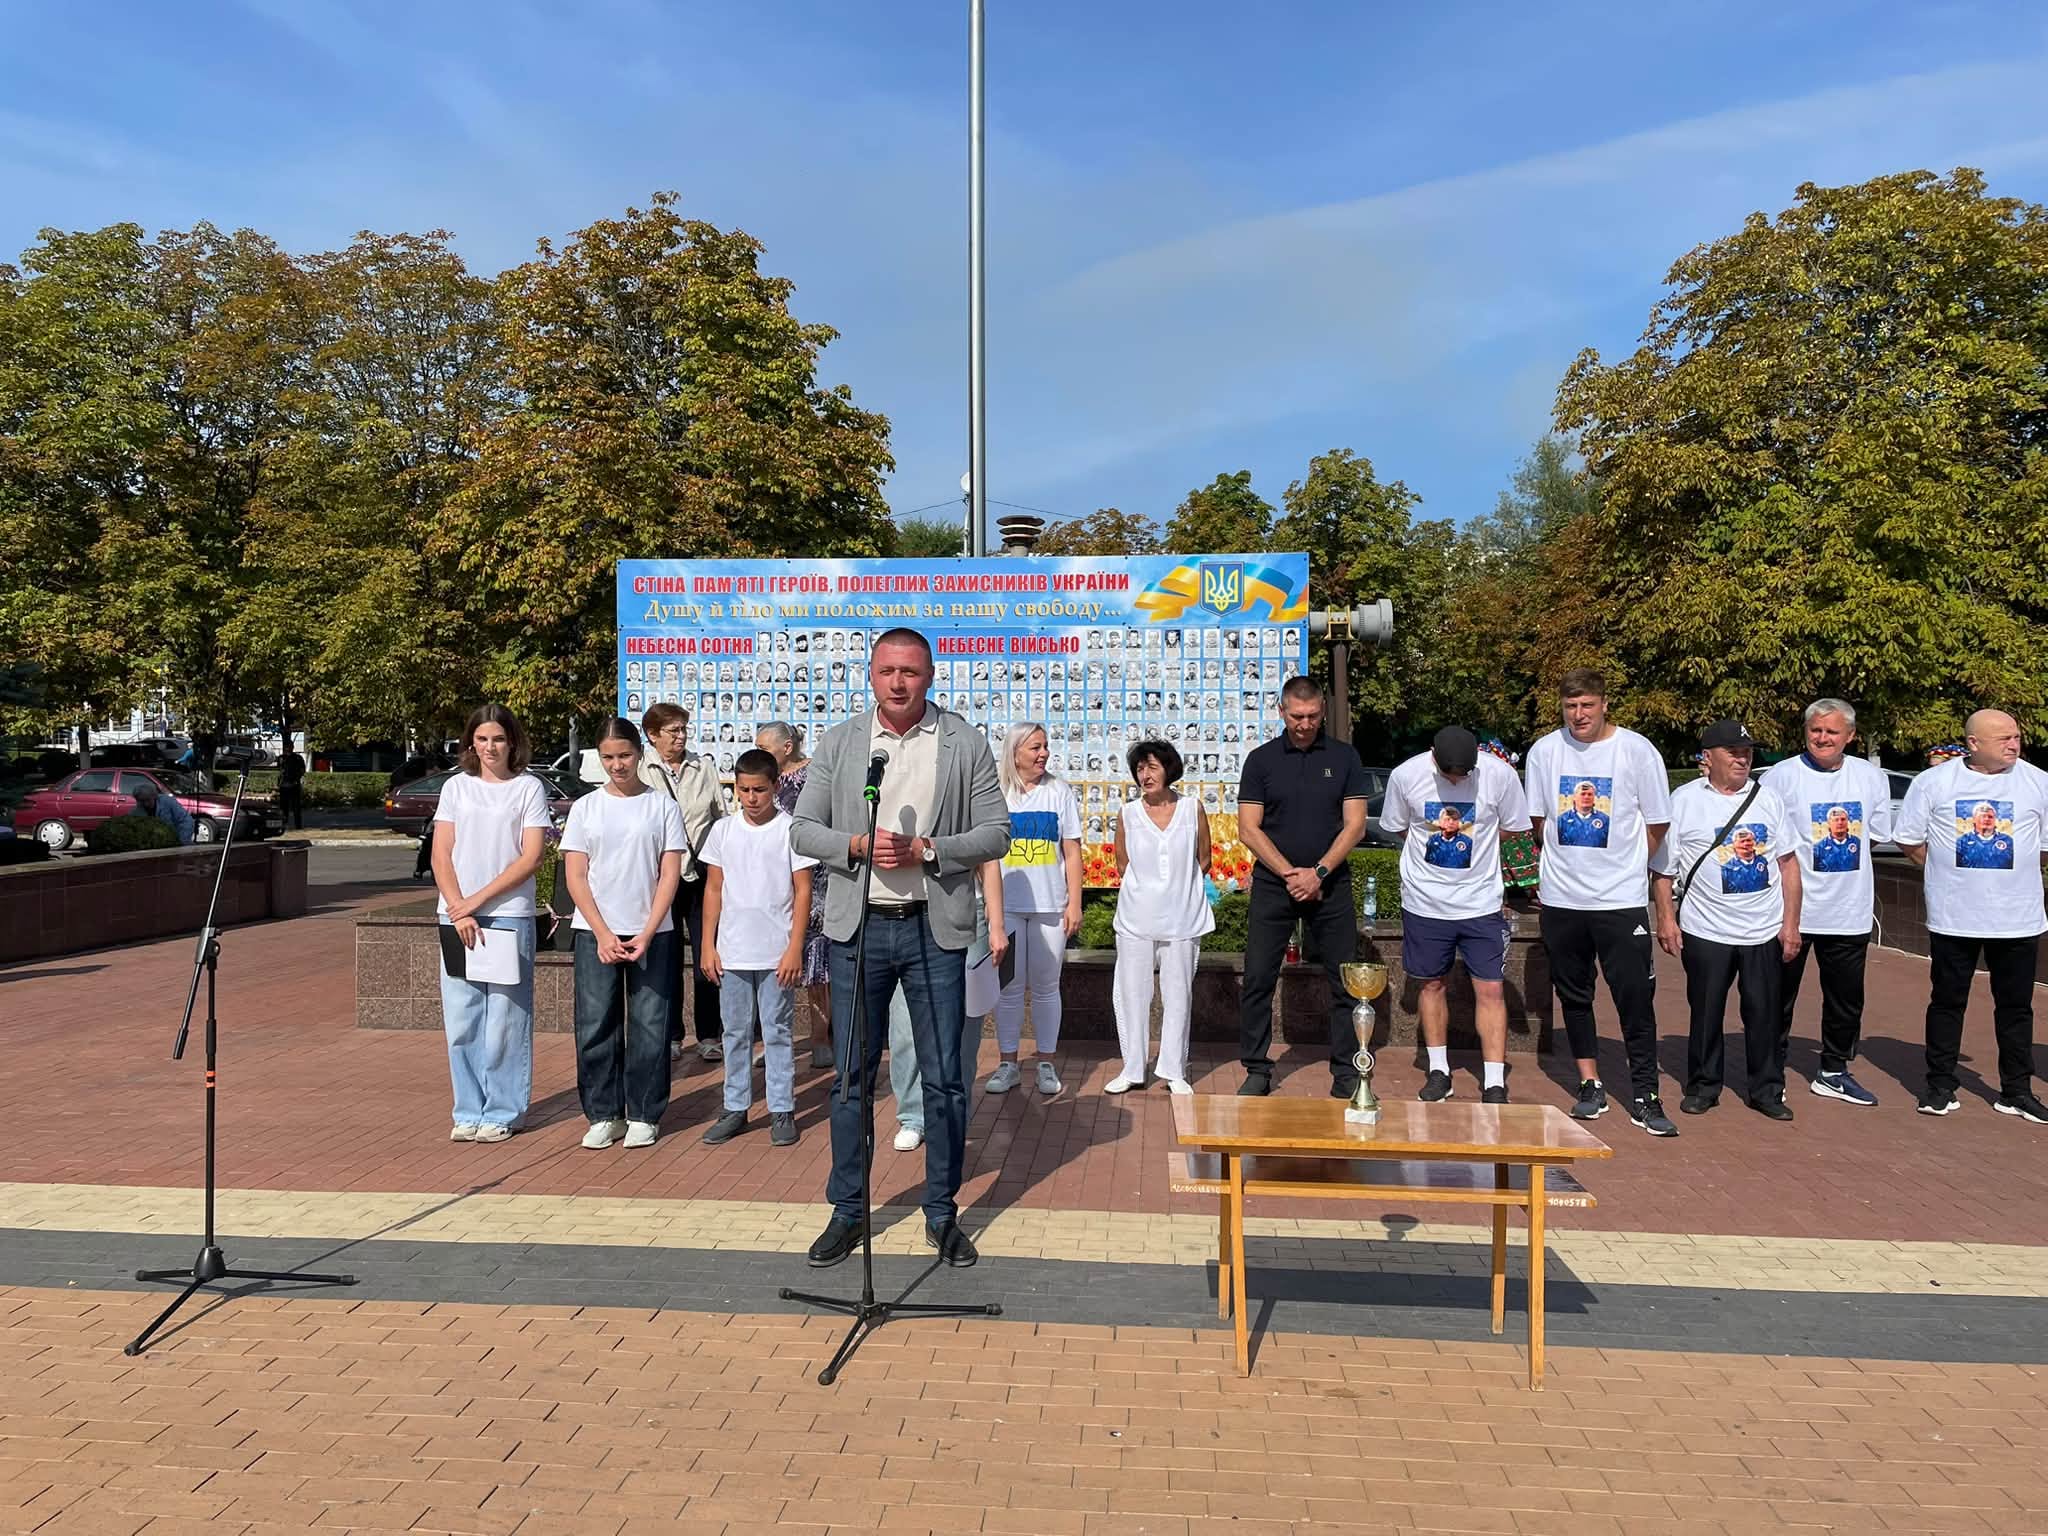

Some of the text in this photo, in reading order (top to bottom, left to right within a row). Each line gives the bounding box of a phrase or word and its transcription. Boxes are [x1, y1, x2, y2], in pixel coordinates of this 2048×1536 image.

[634, 571, 1130, 594] СТІНА ПАМ'ЯТІ ГЕРОЇВ, ПОЛЕГЛИХ ЗАХИСНИКІВ УКРАЇНИ
[643, 598, 1121, 624] Душу й тіло ми положим за нашу свободу...
[626, 637, 753, 655] НЕБЕСНА СОТНЯ
[937, 636, 1006, 654] НЕБЕСНЕ
[1010, 633, 1081, 654] ВІЙСЬКО
